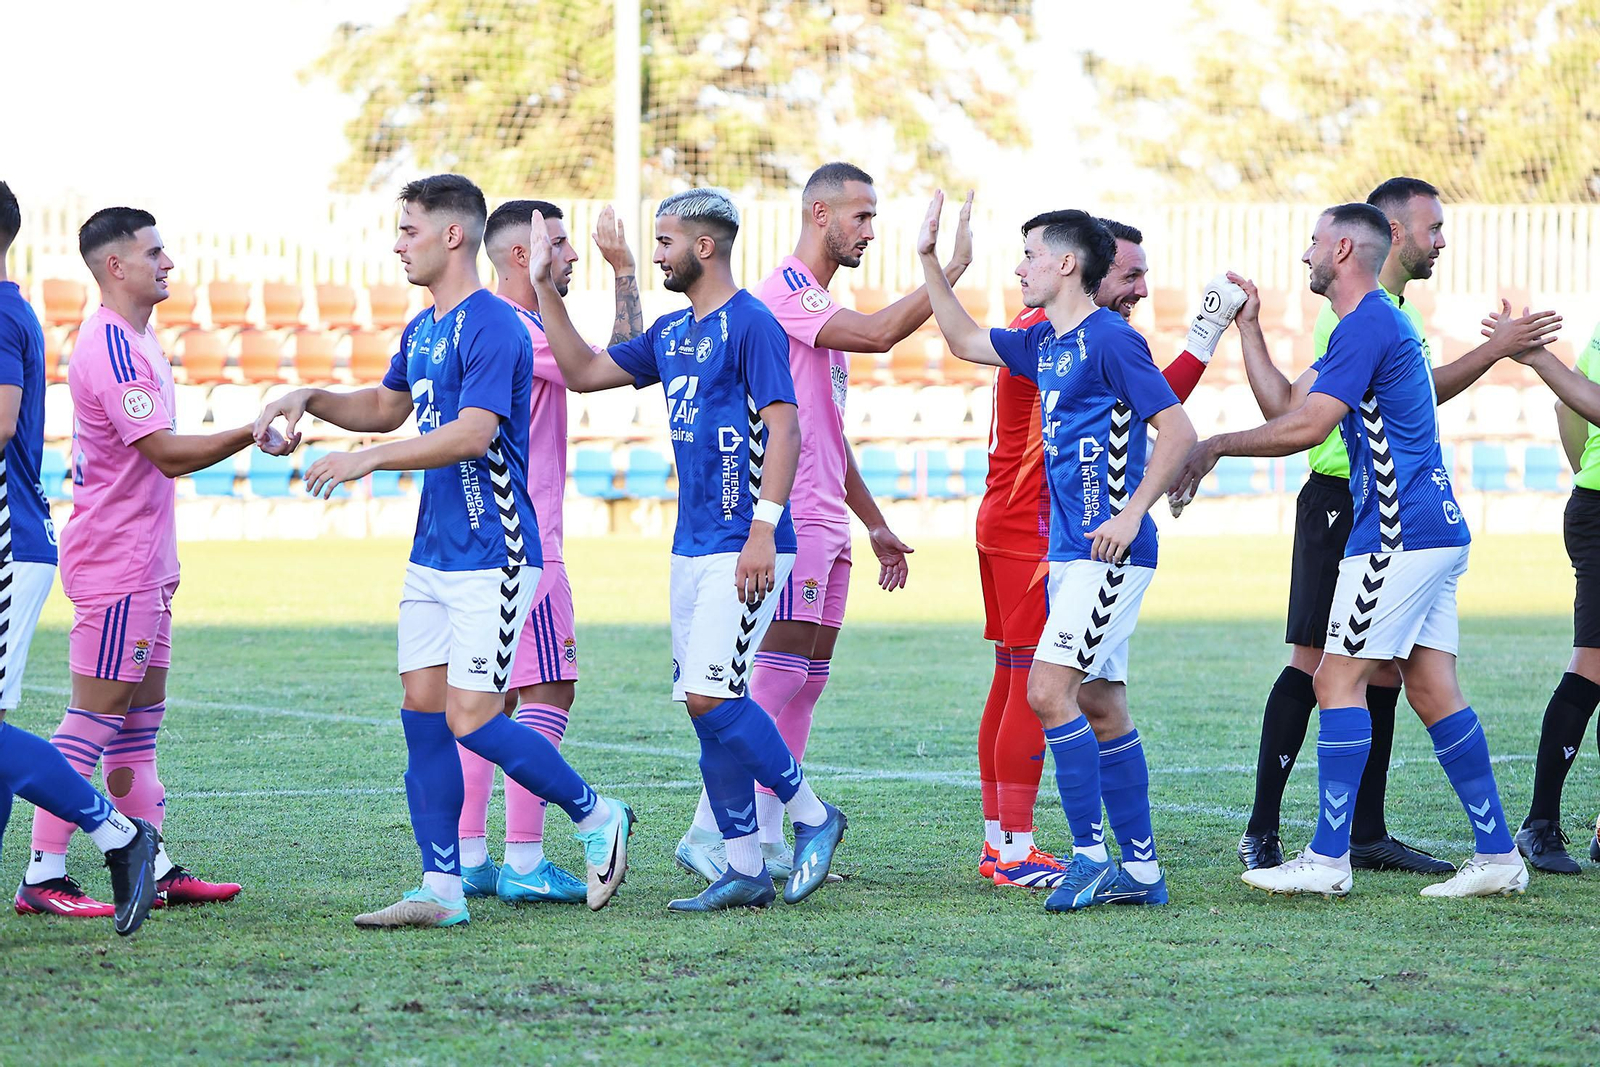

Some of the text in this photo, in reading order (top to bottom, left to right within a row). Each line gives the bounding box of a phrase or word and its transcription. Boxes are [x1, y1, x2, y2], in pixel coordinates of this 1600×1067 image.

[673, 400, 699, 424] Air
[460, 461, 480, 530] INTELIGENTE
[467, 460, 486, 516] LA TIENDA
[722, 455, 733, 521] INTELIGENTE
[730, 455, 739, 509] LA TIENDA
[1081, 465, 1091, 526] INTELIGENTE
[1090, 465, 1100, 518] LA TIENDA
